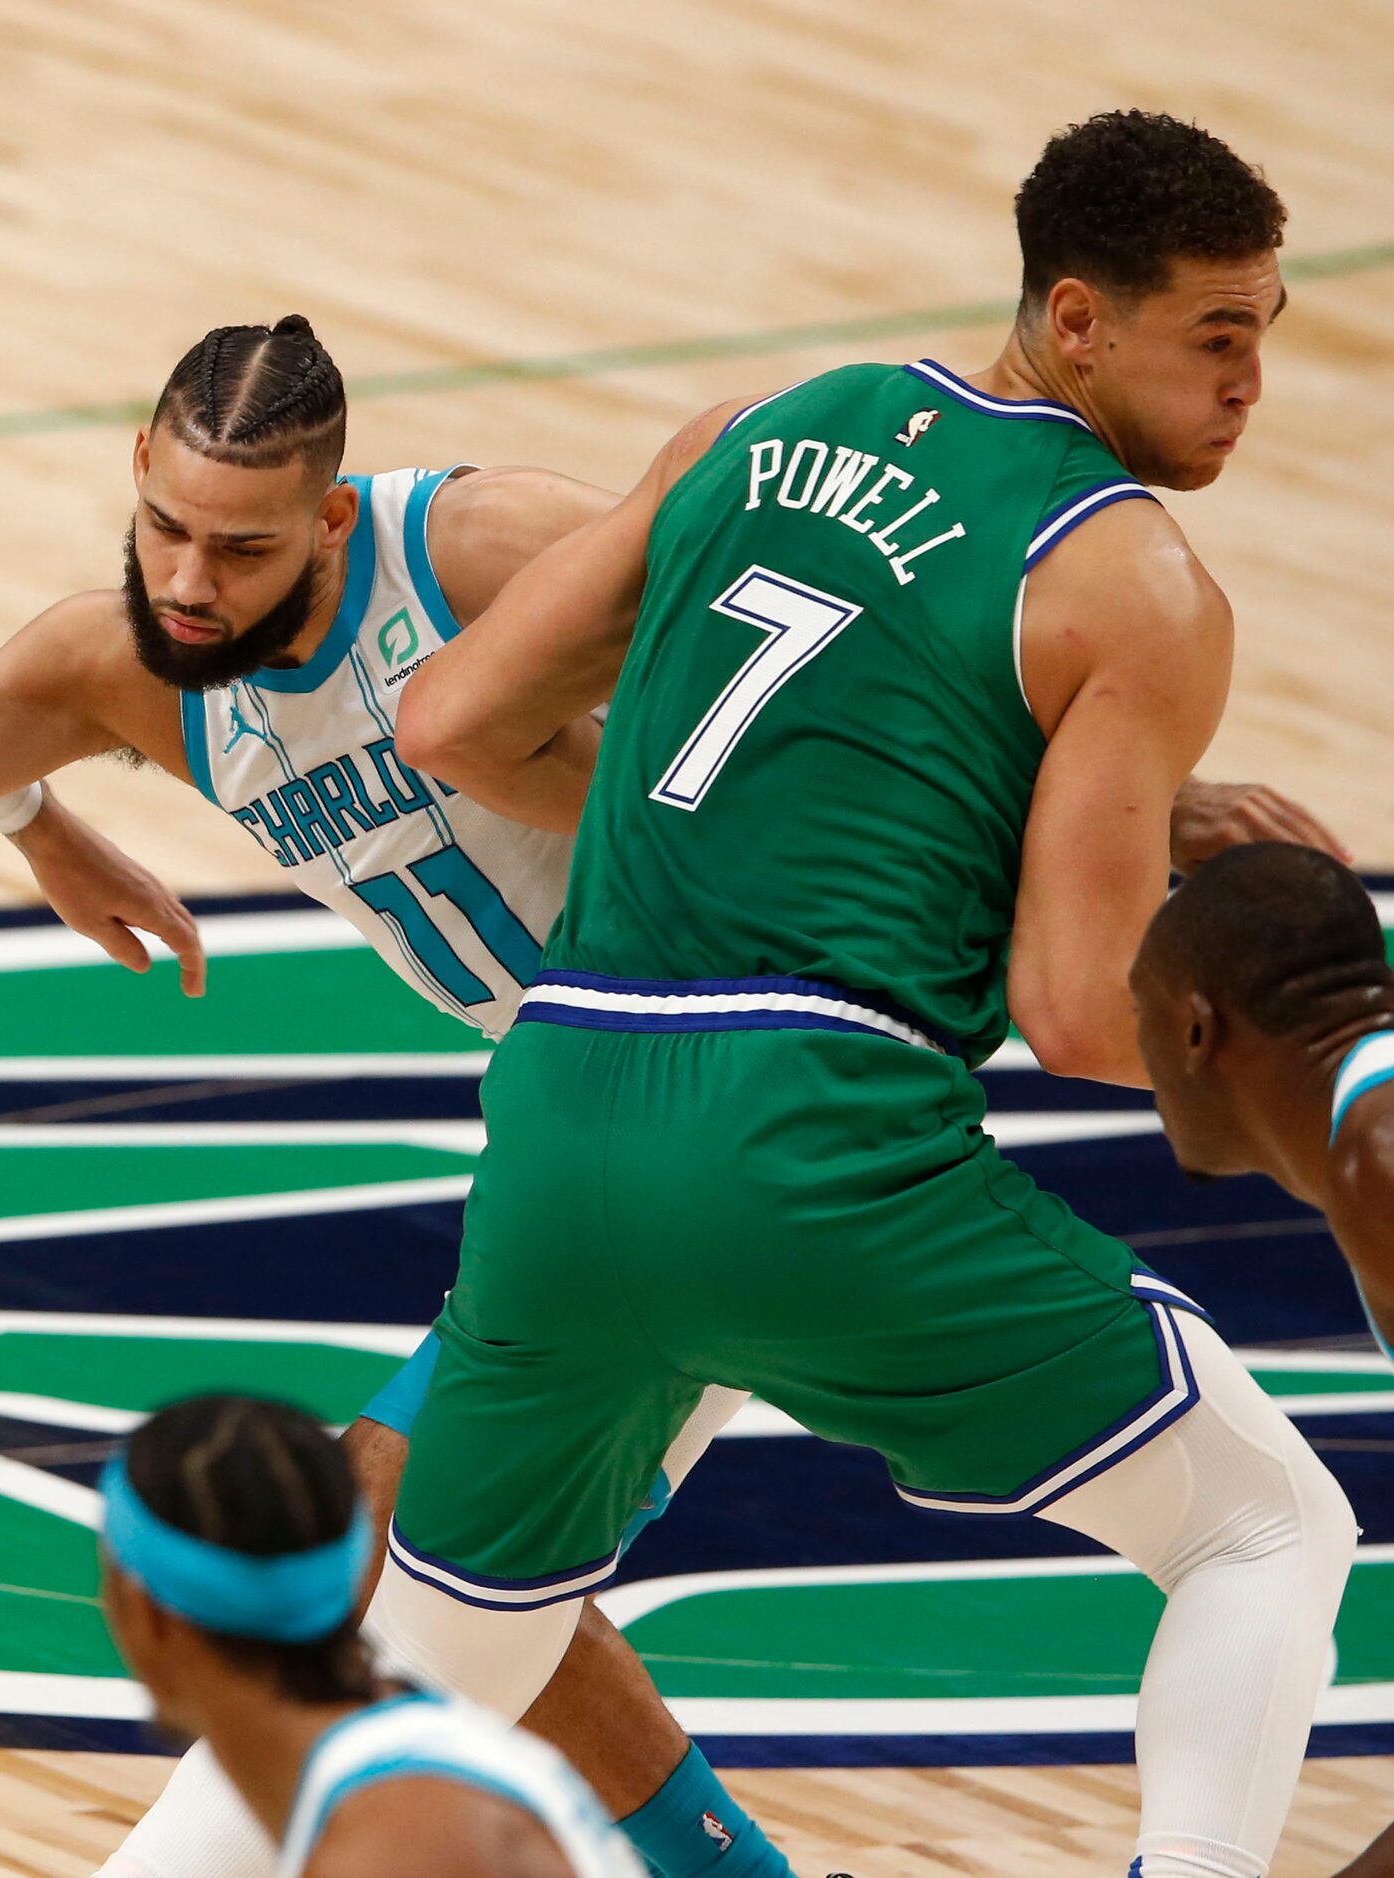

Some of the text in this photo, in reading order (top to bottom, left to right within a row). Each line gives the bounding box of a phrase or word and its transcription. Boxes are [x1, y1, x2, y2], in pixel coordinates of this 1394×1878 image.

[745, 439, 966, 585] POWELL
[648, 564, 864, 812] 7
[229, 736, 460, 868] CHARLO
[349, 843, 544, 1007] 11
